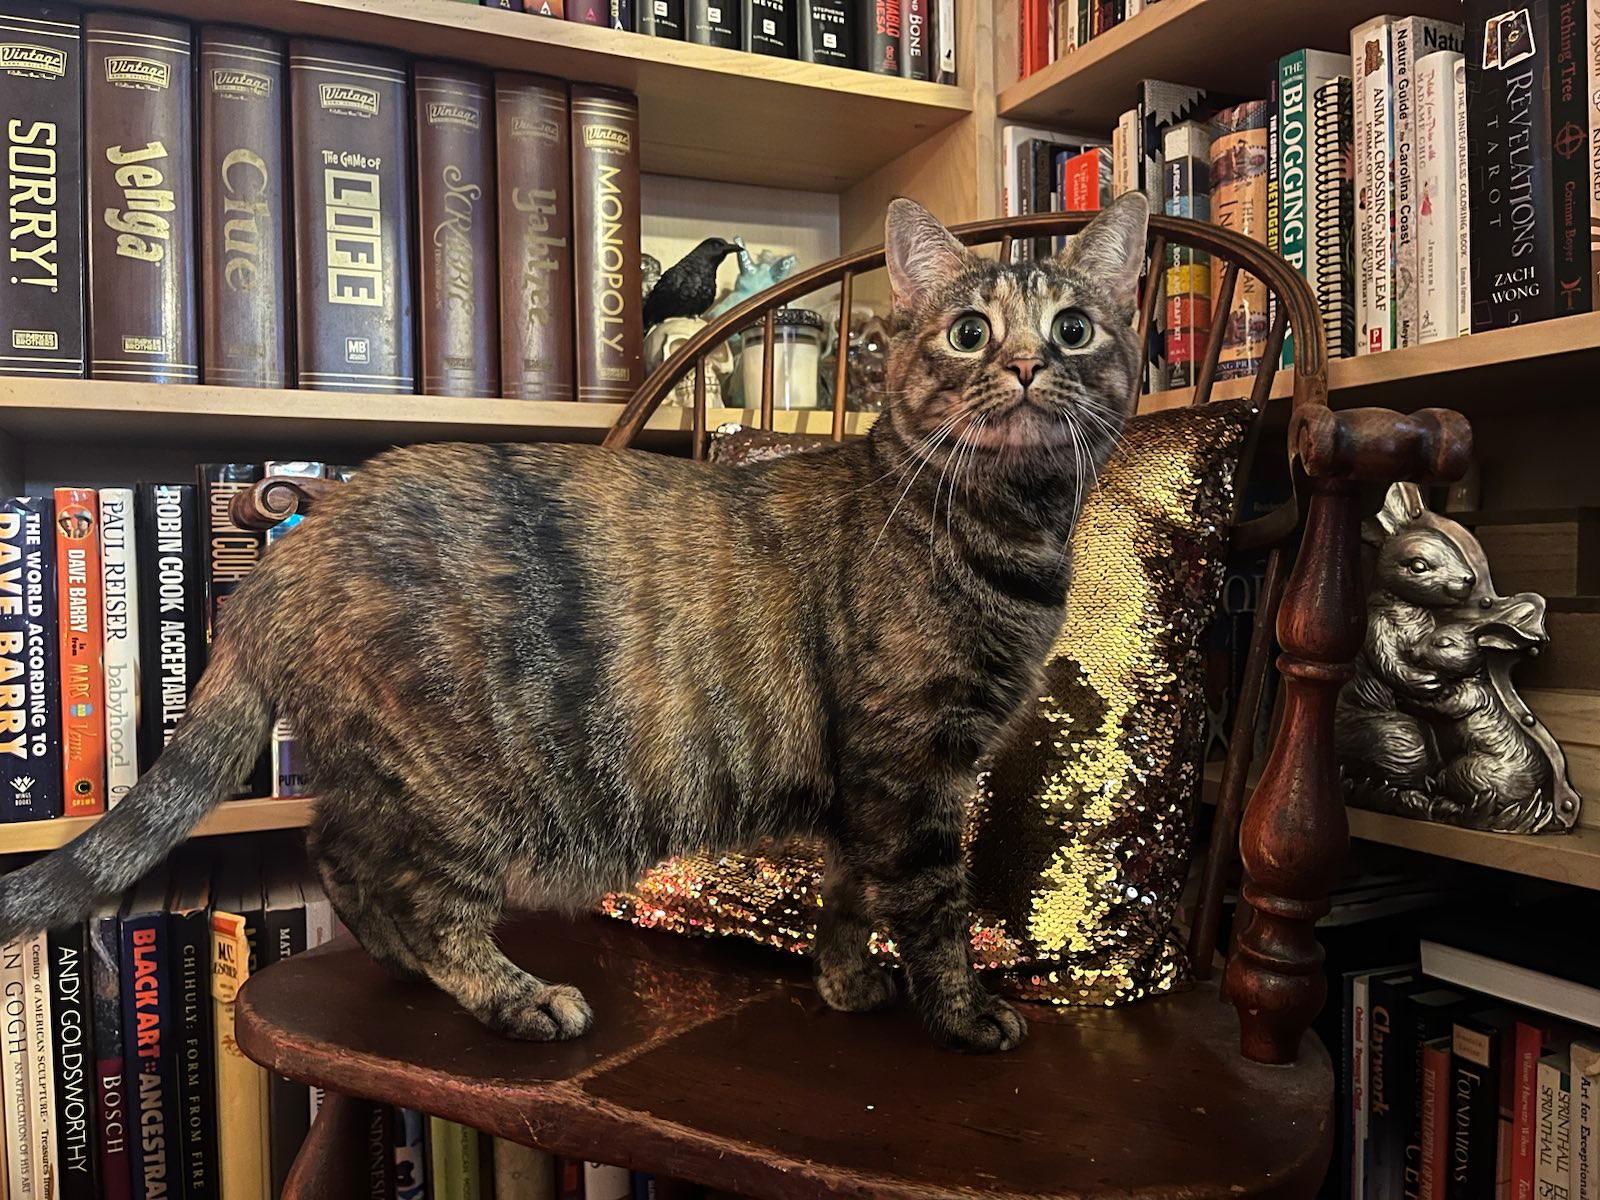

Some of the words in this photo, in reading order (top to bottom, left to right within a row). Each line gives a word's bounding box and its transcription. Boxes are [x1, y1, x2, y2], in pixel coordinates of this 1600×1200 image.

[812, 12, 845, 24] MEYER
[909, 13, 923, 57] BONE
[3, 47, 61, 66] Vintage
[111, 60, 165, 77] Vintage
[1282, 61, 1304, 76] THE
[1397, 28, 1408, 75] Nature
[216, 71, 269, 91] Vintage
[325, 87, 376, 106] Vintage
[1355, 56, 1363, 115] FINANCIAL
[1398, 78, 1410, 120] Guide
[1457, 90, 1466, 110] THE
[1561, 62, 1577, 102] Tree
[431, 104, 478, 122] Vintage
[588, 127, 630, 145] Vintage
[1269, 115, 1278, 133] THE
[1269, 133, 1278, 180] COMPLETE
[1282, 81, 1304, 246] BLOGGING
[1458, 112, 1467, 180] MINDFULNESS
[1505, 69, 1535, 258] REVELATIONS
[1172, 163, 1181, 202] AFRICAN
[1366, 163, 1374, 214] OFFICIAL
[1398, 143, 1411, 201] Carolina
[1486, 115, 1502, 228] TAROT
[8, 119, 58, 287] SORRY!
[104, 141, 176, 263] Jenga
[221, 148, 271, 293] Clue
[1399, 204, 1411, 246] Coast
[1459, 183, 1468, 231] COLORING
[324, 168, 384, 307] LIFE
[1366, 215, 1374, 247] GAME
[1375, 236, 1386, 272] NEW
[1460, 233, 1469, 258] BOOK
[596, 164, 626, 353] MONOPOLY
[1494, 266, 1535, 288] ZACH
[1172, 295, 1181, 327] CRAFT
[1375, 275, 1387, 312] LEAF
[1492, 283, 1541, 305] WONG
[15, 339, 55, 348] BROTHERS
[348, 340, 367, 355] MB
[1172, 327, 1181, 341] KIT
[25, 513, 41, 545] THE
[102, 500, 125, 557] PAUL
[156, 490, 182, 553] ROBIN
[0, 513, 22, 616] DAVE
[26, 551, 42, 617] WORLD
[67, 547, 87, 584] DAVE
[158, 556, 184, 613] COOK
[69, 586, 88, 633] BARRY
[104, 561, 128, 642] REISER
[71, 636, 80, 657] from
[79, 642, 87, 651] is
[0, 631, 28, 760] BARRY
[29, 622, 46, 728] ACCORDING
[69, 663, 90, 698] MARS
[160, 619, 187, 725] ACCEPTABLE
[104, 662, 130, 768] babyhood
[32, 732, 47, 758] TO
[30, 944, 42, 981] Century
[58, 946, 80, 1005] ANDY
[133, 928, 159, 1009] BLACK
[33, 983, 43, 995] of
[183, 943, 197, 1031] CHIHULY:
[5, 981, 27, 1056] GOGH
[34, 996, 46, 1052] AMERICAN
[136, 1011, 161, 1059] ART
[186, 1039, 199, 1087] FORM
[1370, 1005, 1390, 1115] Claywork
[37, 1055, 49, 1117] SCULPTURE
[60, 1009, 87, 1173] GOLDSWORTHY
[1580, 1076, 1591, 1099] Art
[13, 1078, 27, 1142] APPRECIATION
[102, 1074, 124, 1154] BOSCH
[187, 1095, 201, 1142] FROM
[1453, 1068, 1481, 1184] FOUNDATIONS
[1540, 1084, 1553, 1166] SPRINTHALL
[1556, 1091, 1570, 1173] SPRINTHALL
[1580, 1102, 1591, 1123] for
[18, 1143, 28, 1157] OF
[19, 1158, 29, 1175] HIS
[40, 1128, 51, 1176] Treasures
[191, 1151, 205, 1189] FIRE
[20, 1175, 31, 1195] ART
